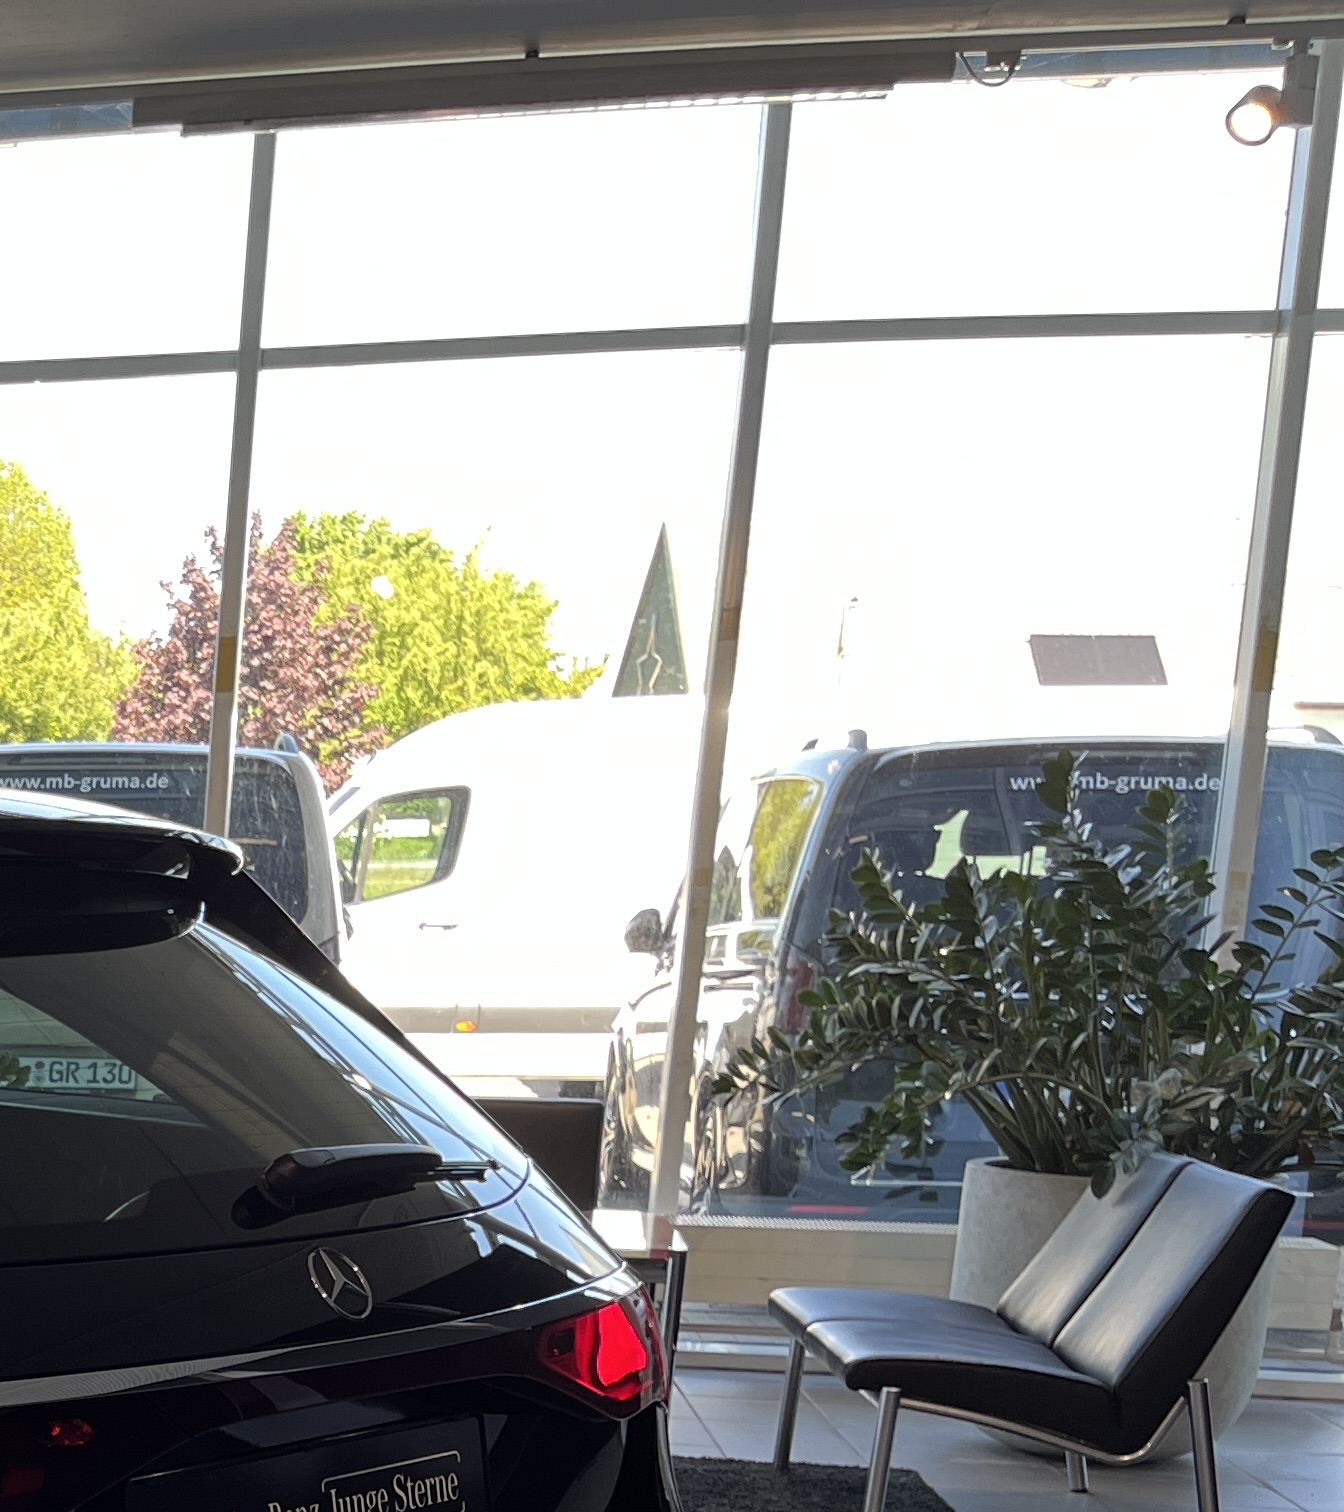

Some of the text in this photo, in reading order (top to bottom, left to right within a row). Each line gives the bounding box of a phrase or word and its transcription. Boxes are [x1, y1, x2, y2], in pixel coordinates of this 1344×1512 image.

[1010, 773, 1221, 794] wmb-gruma.de
[48, 1061, 132, 1085] GR 130
[393, 1472, 459, 1512] Sterne
